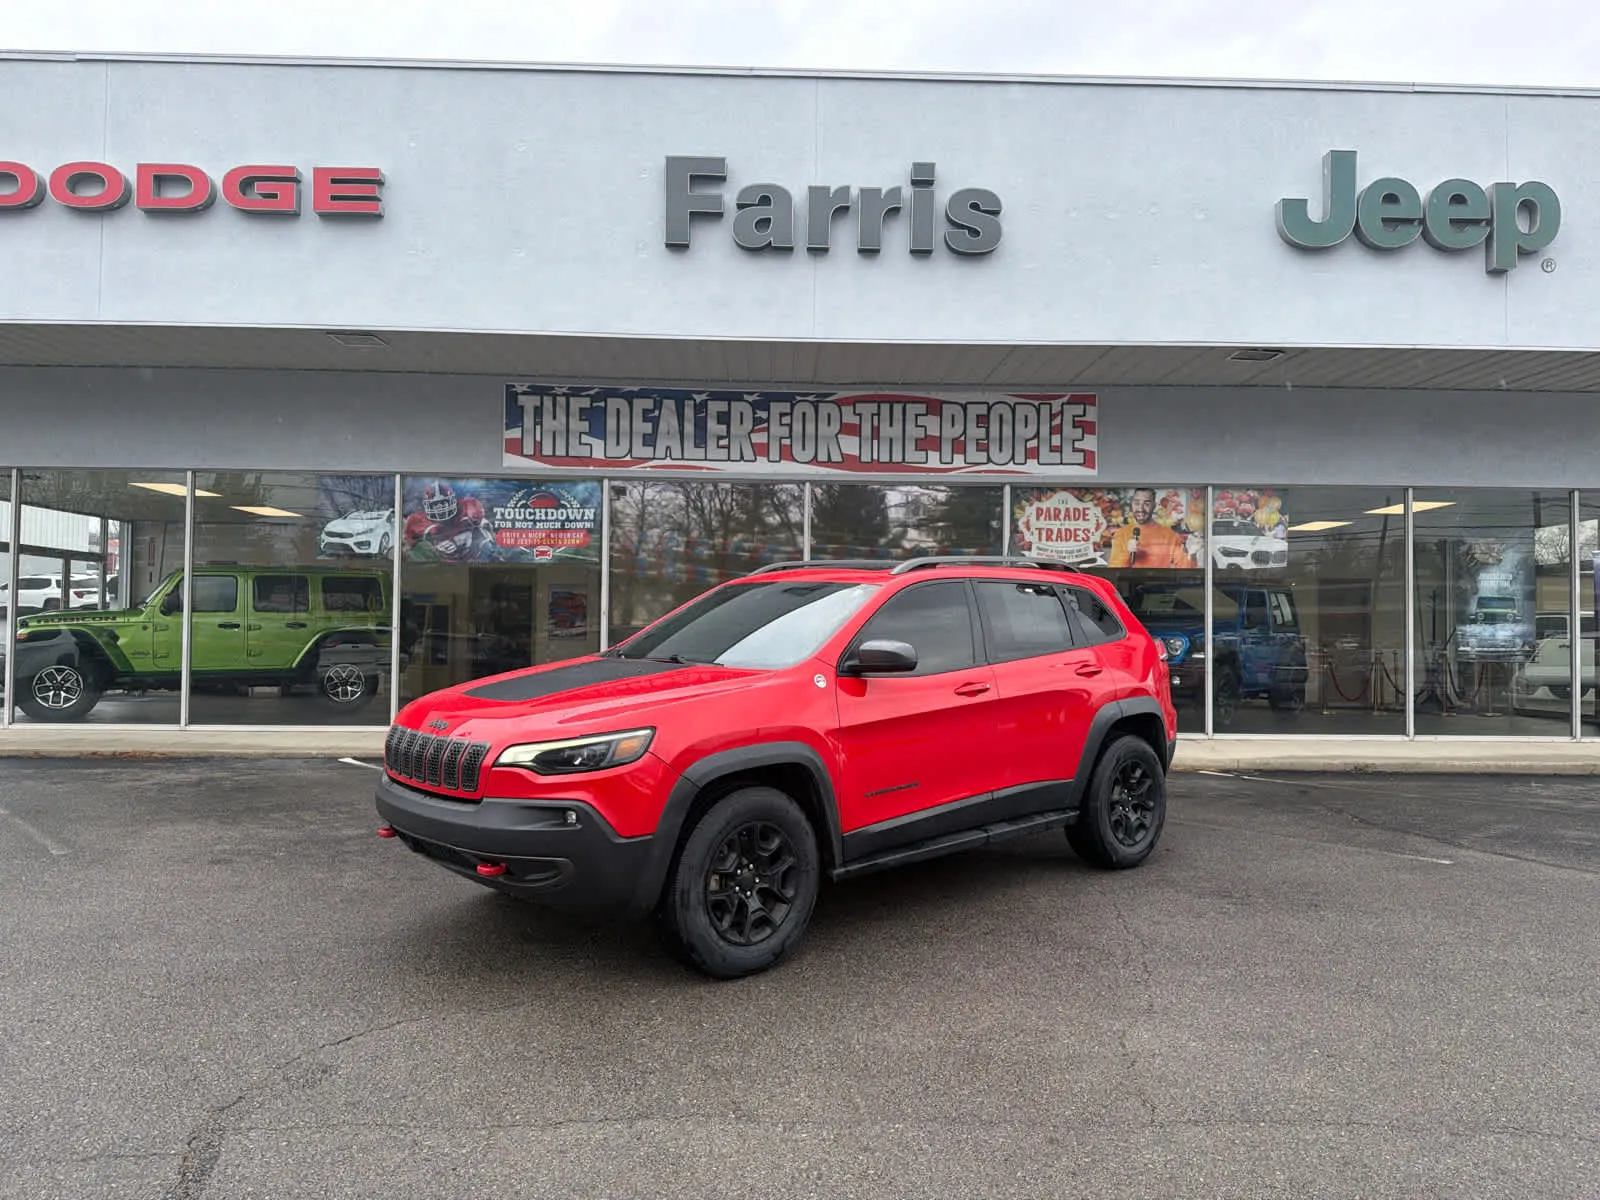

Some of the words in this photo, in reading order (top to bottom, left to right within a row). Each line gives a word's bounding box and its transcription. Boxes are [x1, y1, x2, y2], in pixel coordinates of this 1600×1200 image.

[664, 157, 1003, 256] Farris
[1275, 150, 1562, 273] Jeep
[517, 394, 593, 457] THE
[603, 397, 757, 462] DEALER
[767, 400, 844, 464] FOR
[853, 401, 928, 464] THE
[939, 401, 1086, 465] PEOPLE
[493, 507, 596, 520] TOUCHDOWN
[1035, 507, 1090, 521] PARADE
[494, 521, 512, 529] FOR
[515, 521, 533, 529] NOT
[536, 521, 561, 529] MUCH
[564, 521, 594, 529] DOWN!
[1035, 527, 1091, 542] TRADES
